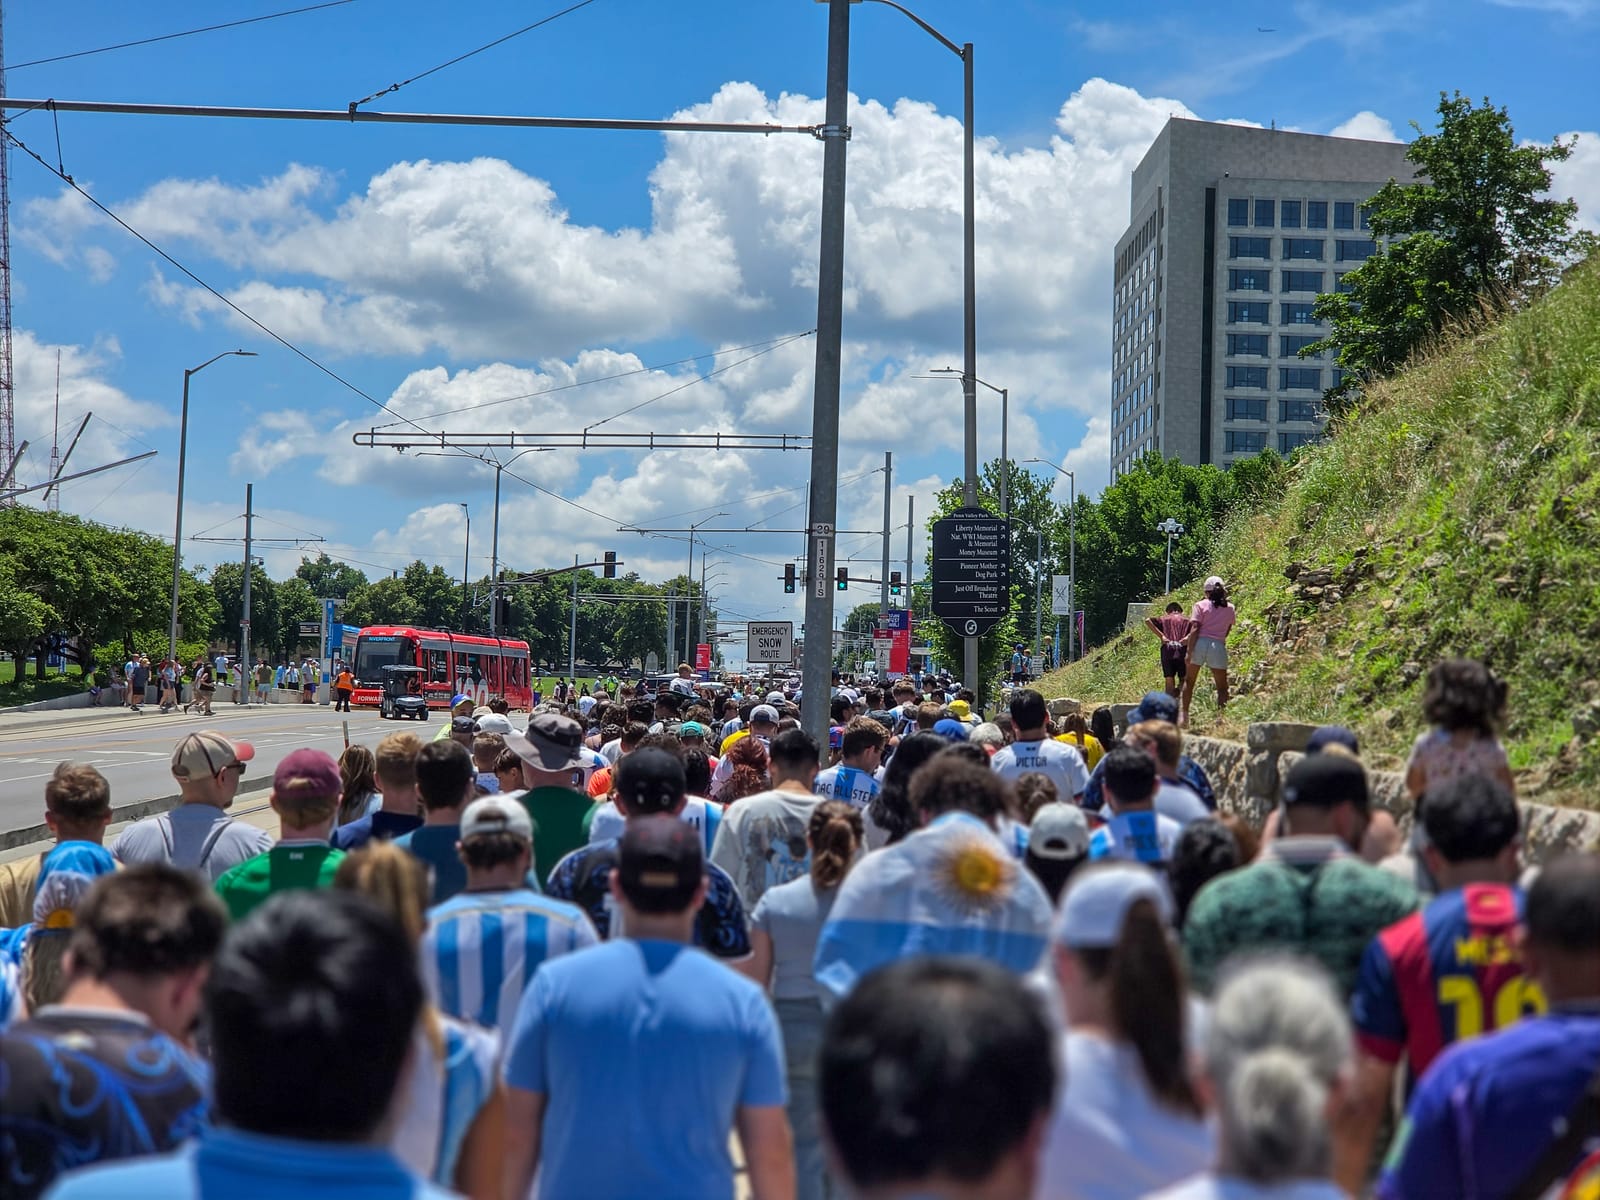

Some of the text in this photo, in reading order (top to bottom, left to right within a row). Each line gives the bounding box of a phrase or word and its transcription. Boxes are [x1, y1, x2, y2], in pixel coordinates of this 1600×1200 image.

[817, 525, 830, 534] 29
[955, 524, 973, 533] Liberty
[959, 549, 976, 557] Money
[960, 562, 998, 570] Pioneer Mother
[975, 571, 986, 579] Dog
[955, 584, 998, 593] Just Off Broadway
[979, 591, 998, 599] Theatre
[973, 605, 998, 613] The Scout
[752, 626, 788, 636] EMERGENCY
[758, 638, 782, 648] SNOW
[760, 650, 780, 658] ROUTE
[1016, 756, 1047, 768] VICTOR
